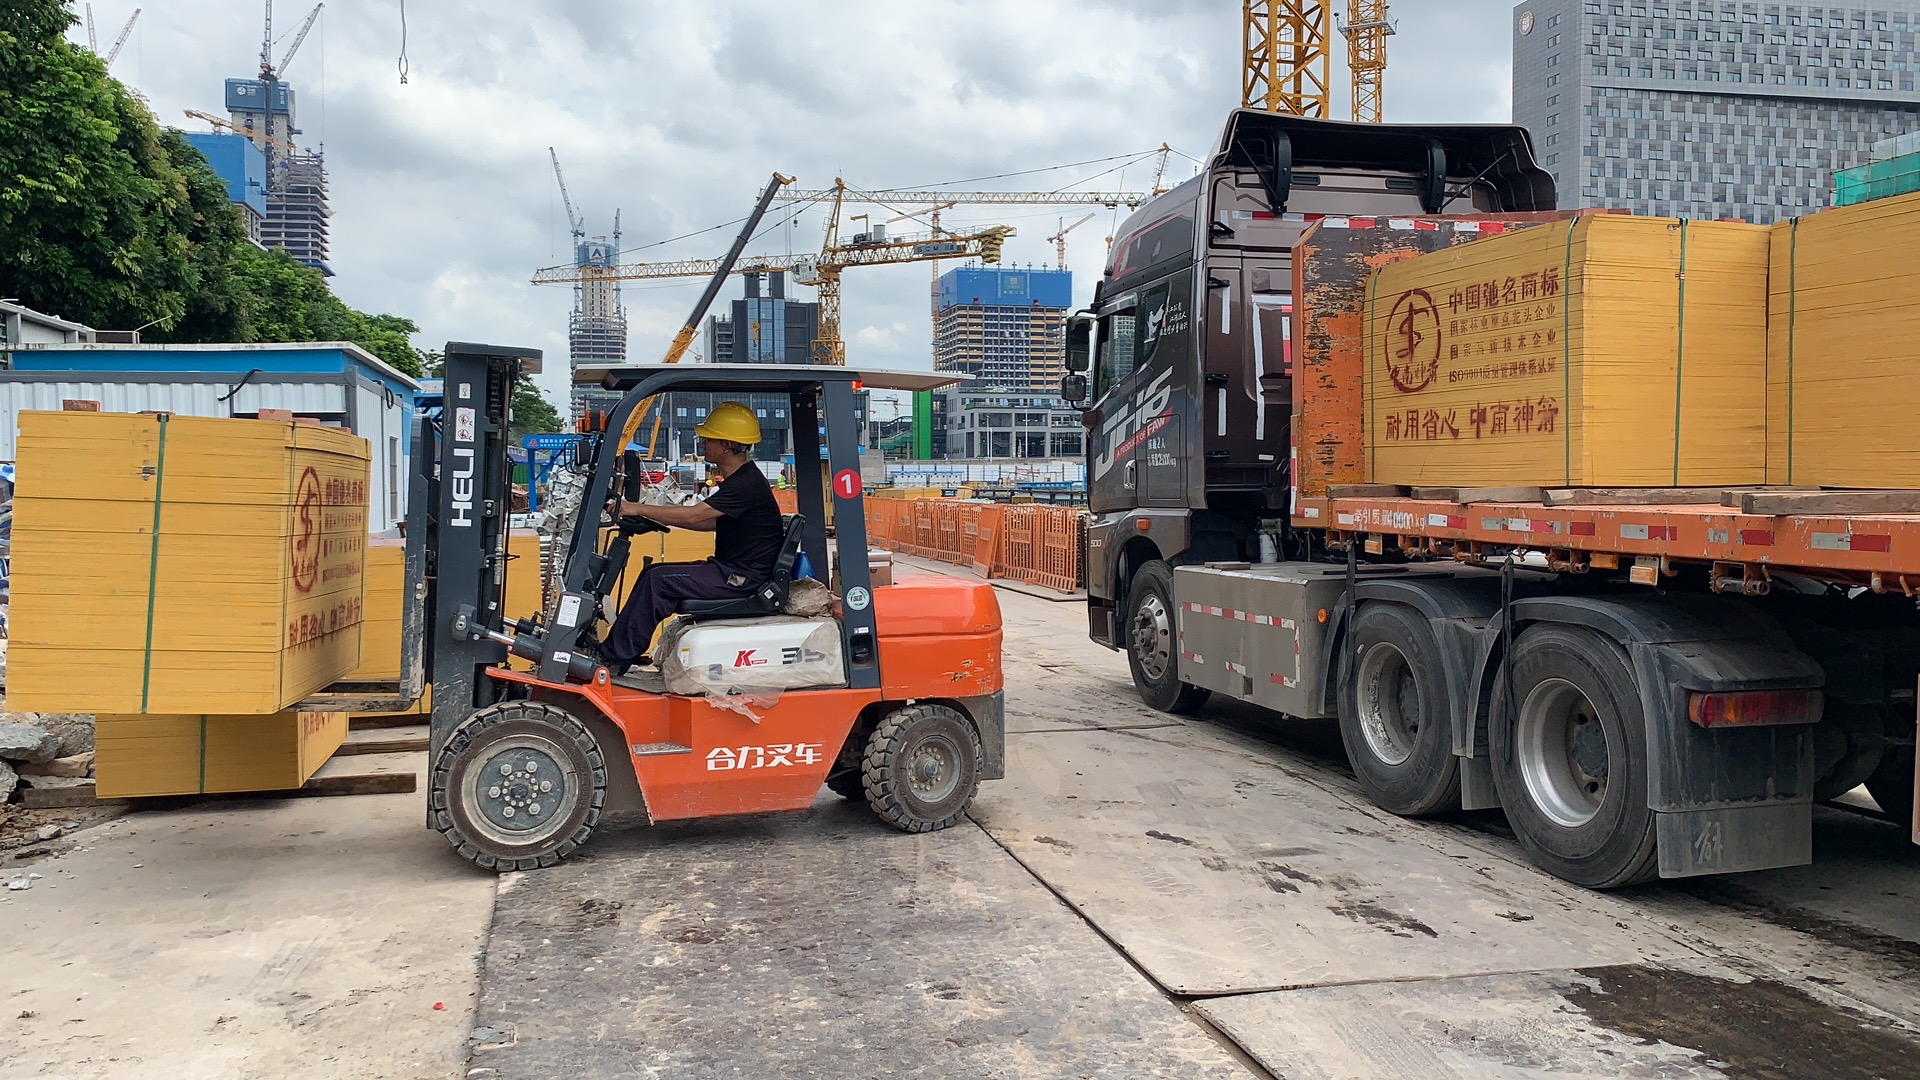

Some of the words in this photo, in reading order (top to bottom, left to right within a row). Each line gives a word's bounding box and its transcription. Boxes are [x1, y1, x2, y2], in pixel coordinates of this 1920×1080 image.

[1146, 417, 1166, 437] FAW
[1385, 408, 1460, 441] 耐用省心
[451, 448, 475, 527] HELI
[840, 474, 852, 494] 1
[1415, 513, 1425, 531] kg
[734, 649, 757, 667] K
[705, 743, 823, 771] 合力叉车
